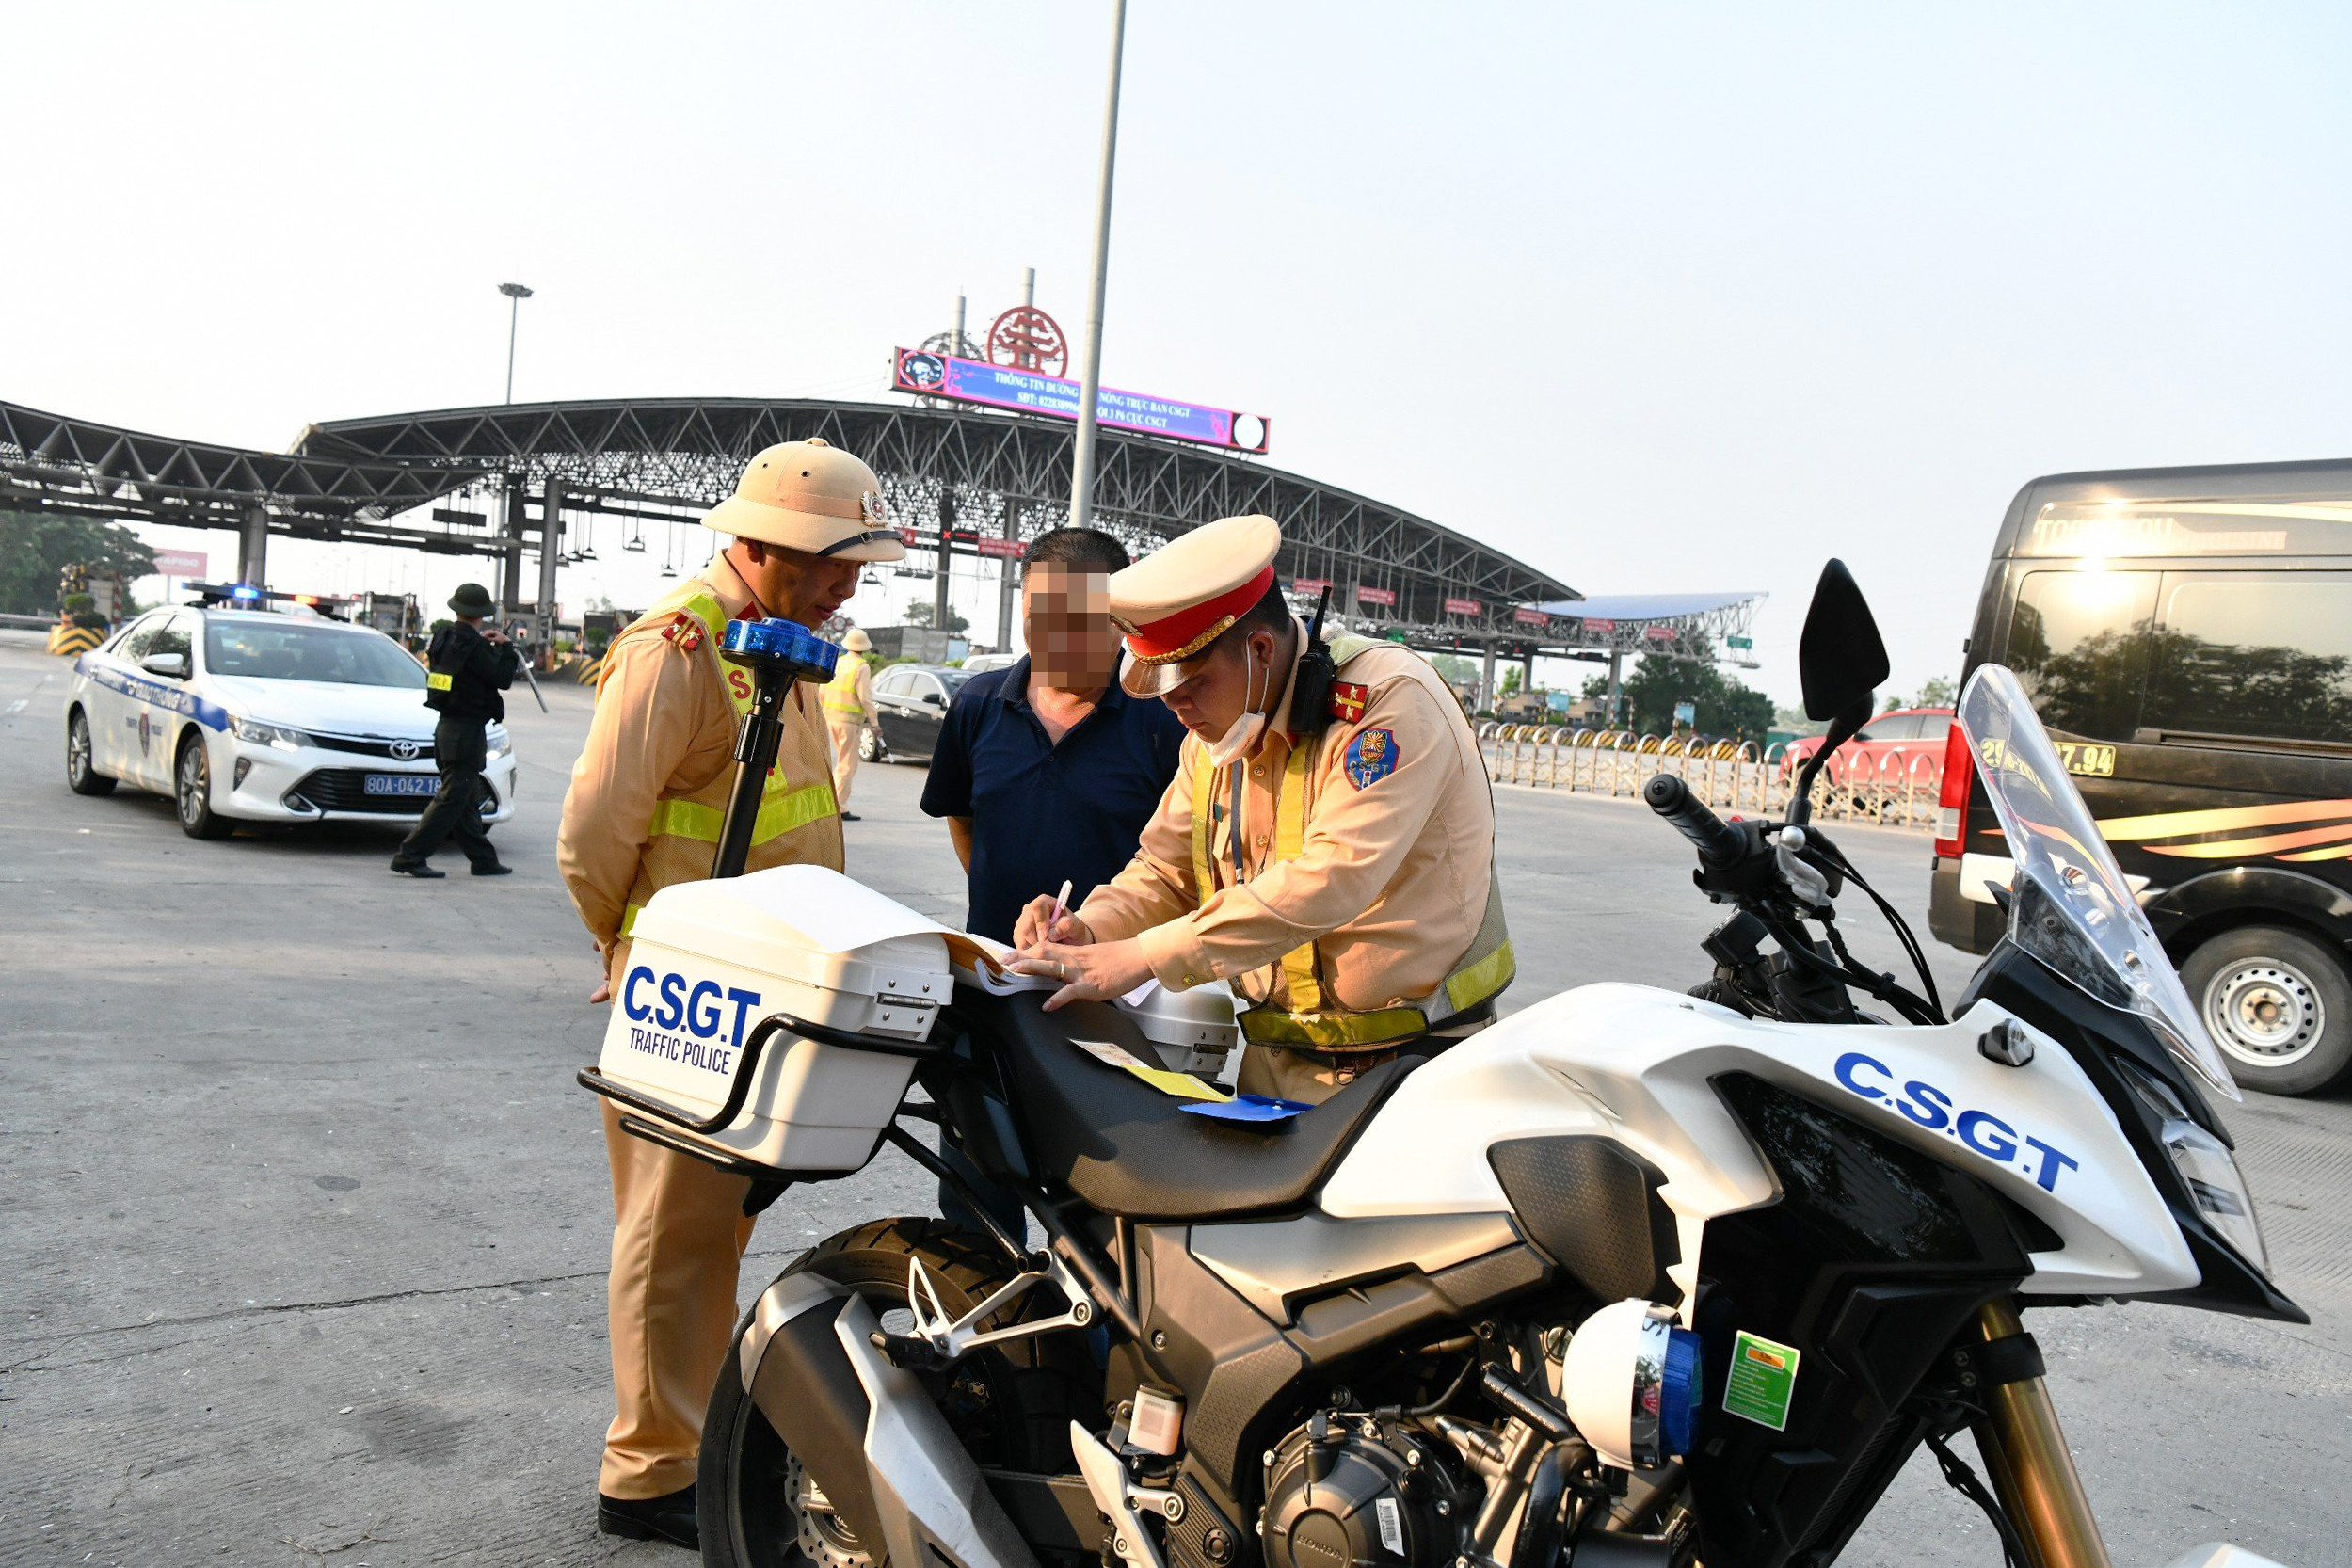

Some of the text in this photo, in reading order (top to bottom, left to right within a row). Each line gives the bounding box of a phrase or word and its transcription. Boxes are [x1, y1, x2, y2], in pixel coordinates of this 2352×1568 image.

[1029, 378, 1045, 391] TIN
[1099, 392, 1125, 406] NÓNG
[1150, 402, 1167, 414] BAN
[1168, 406, 1191, 418] CSGT
[1144, 416, 1167, 428] CSGT
[624, 966, 761, 1048] C.S.G.T
[630, 1027, 731, 1075] TRAFFIC POLICE
[1834, 1052, 2079, 1193] C.S.G.T
[1296, 1534, 1344, 1561] HONDA
